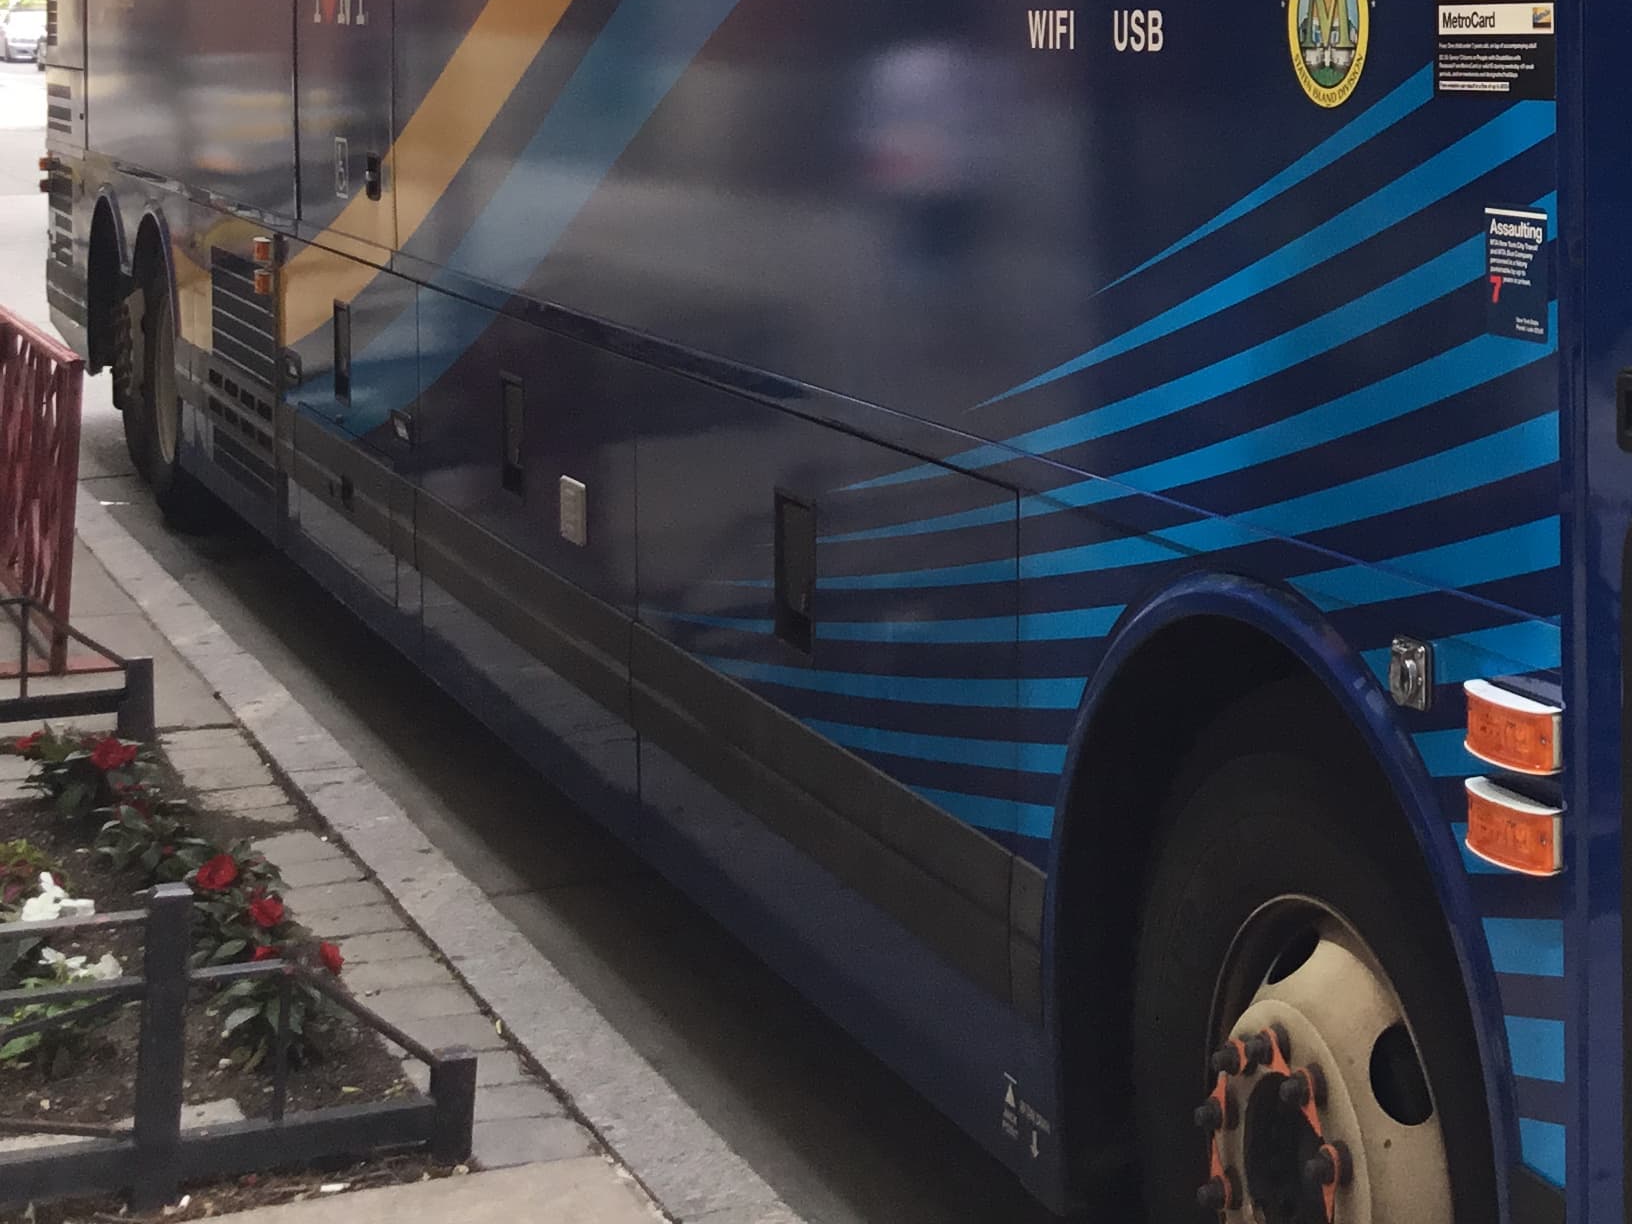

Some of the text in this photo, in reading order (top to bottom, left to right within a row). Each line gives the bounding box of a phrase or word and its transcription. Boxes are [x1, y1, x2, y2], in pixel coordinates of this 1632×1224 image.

[1028, 10, 1075, 50] WIFI
[1113, 9, 1164, 52] USB
[1442, 11, 1496, 29] MetroCard
[1490, 218, 1543, 244] Assaulting
[1489, 274, 1503, 304] 7
